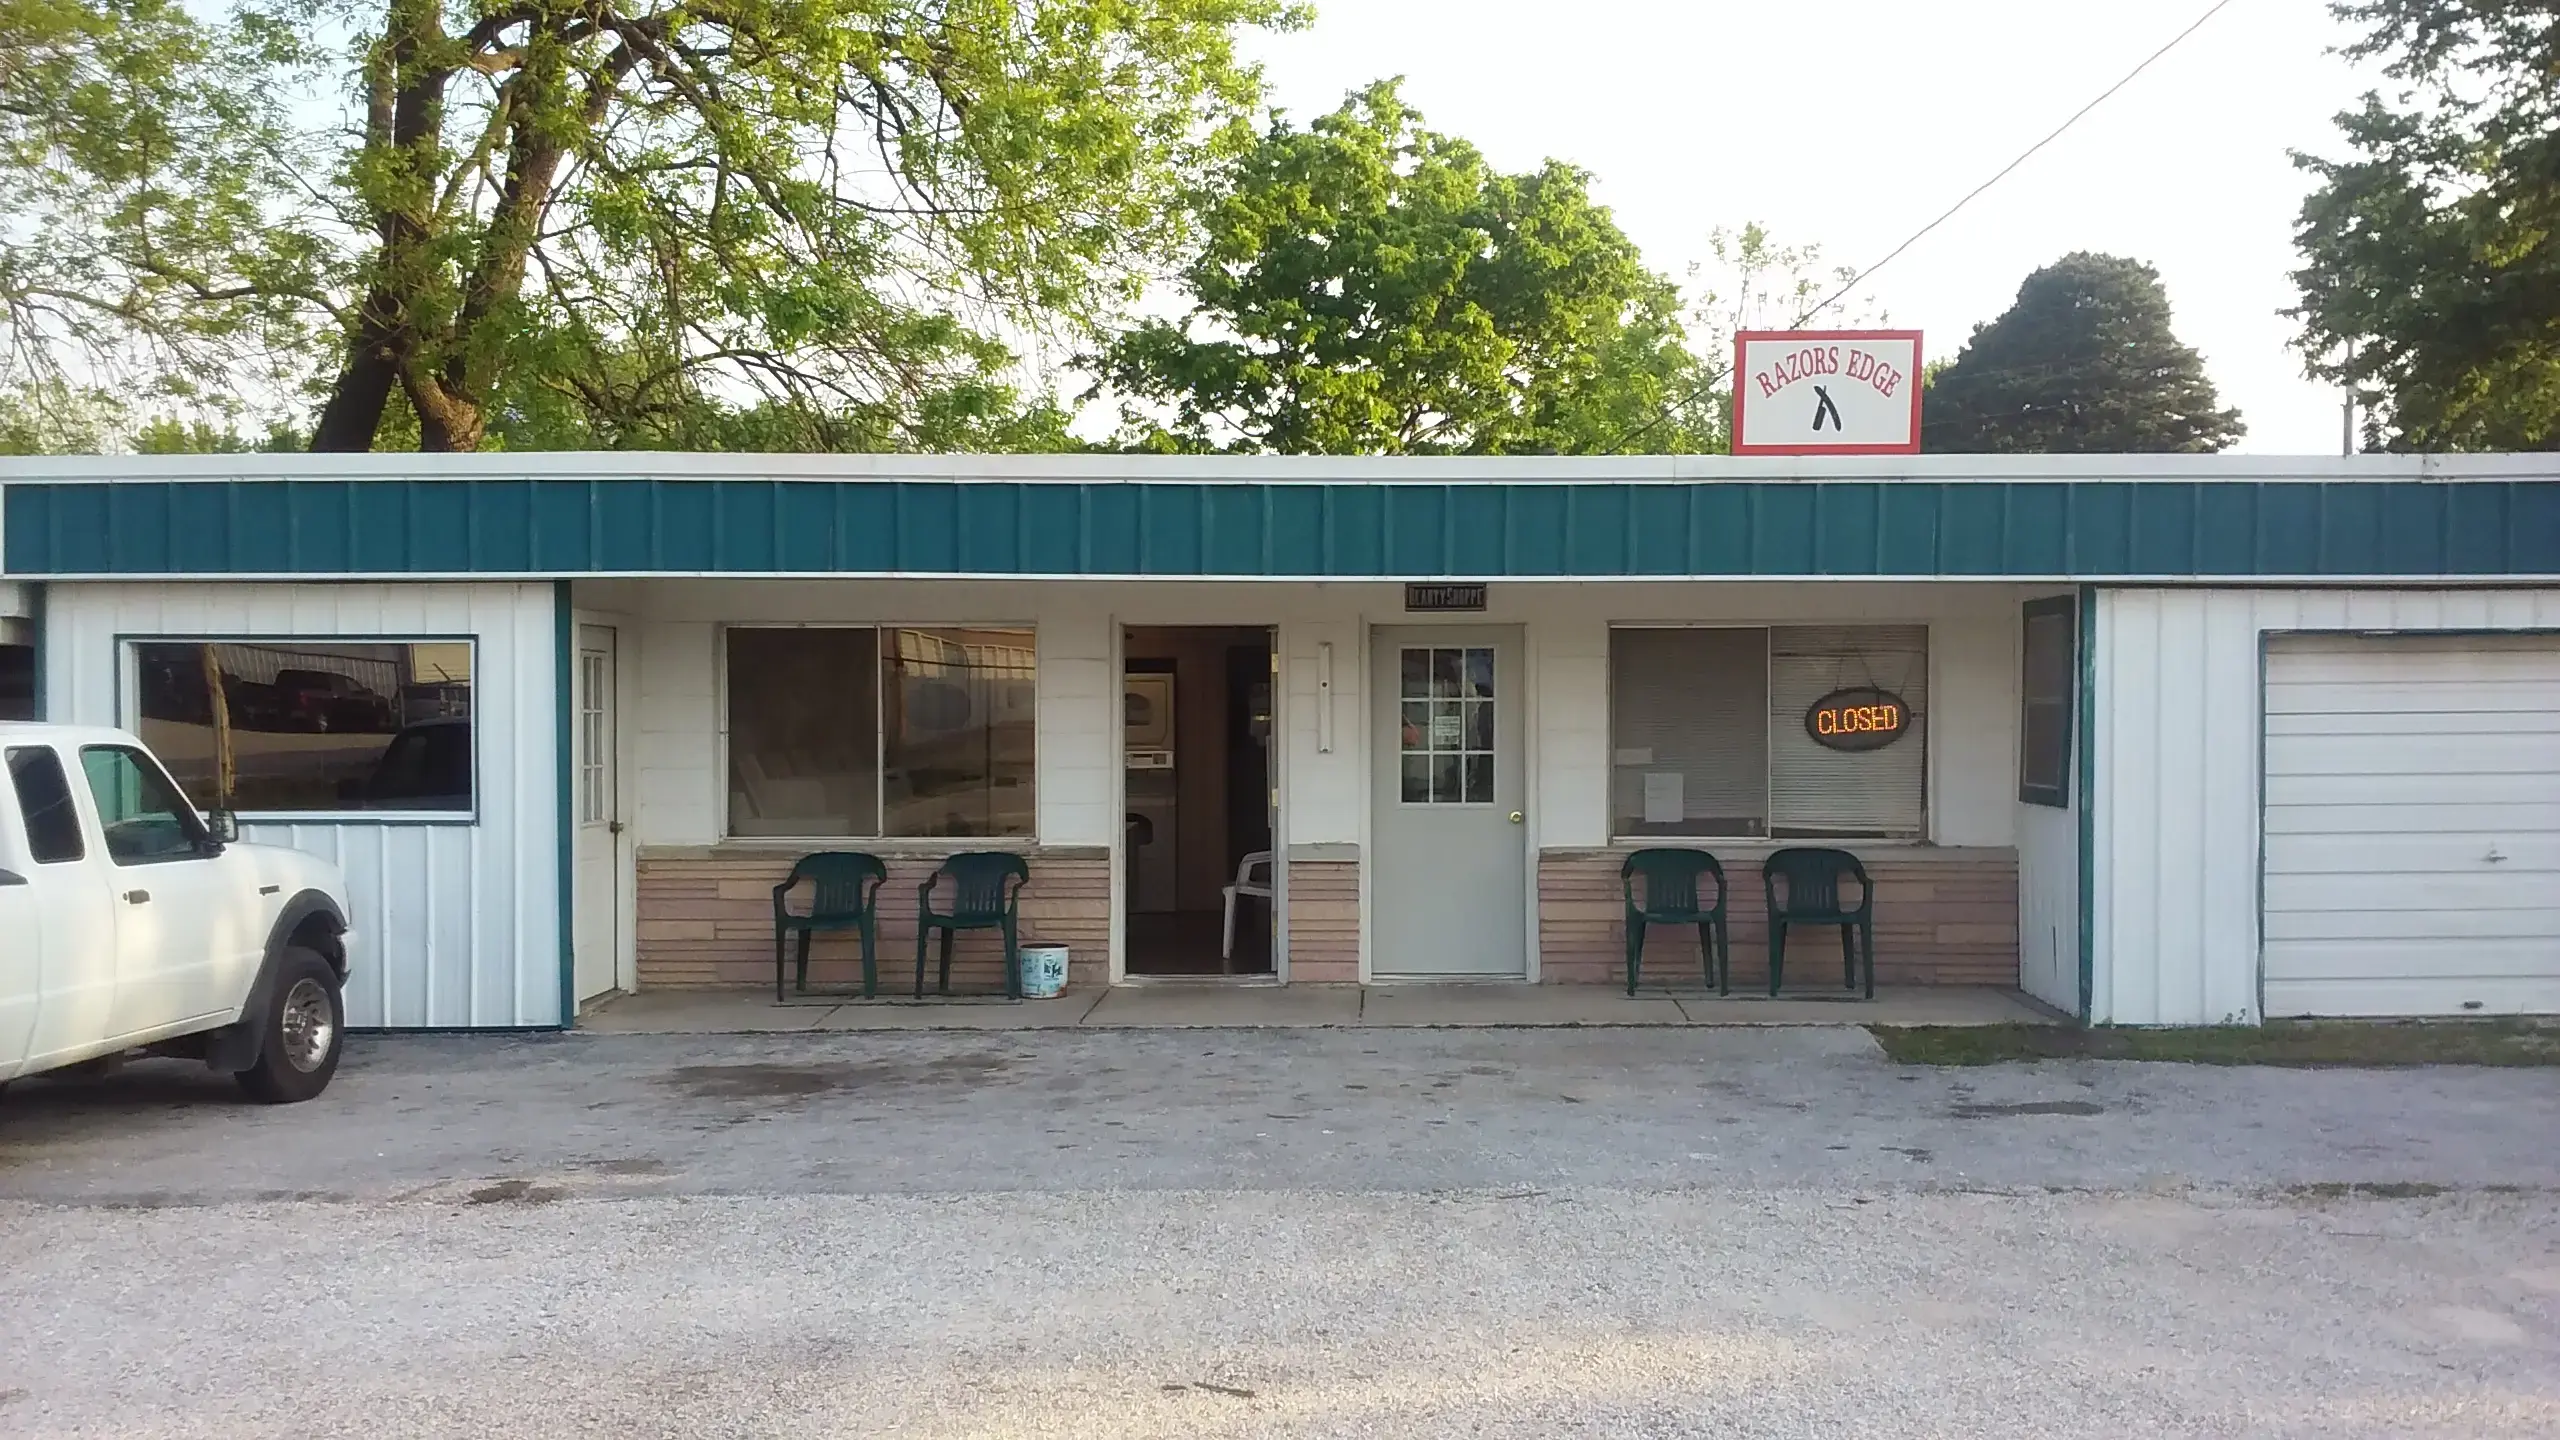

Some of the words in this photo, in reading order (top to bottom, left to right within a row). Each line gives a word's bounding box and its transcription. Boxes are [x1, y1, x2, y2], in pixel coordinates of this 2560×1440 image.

[1756, 346, 1839, 398] RAZORS
[1845, 349, 1902, 398] EDGE
[1818, 705, 1898, 734] CLOSED
